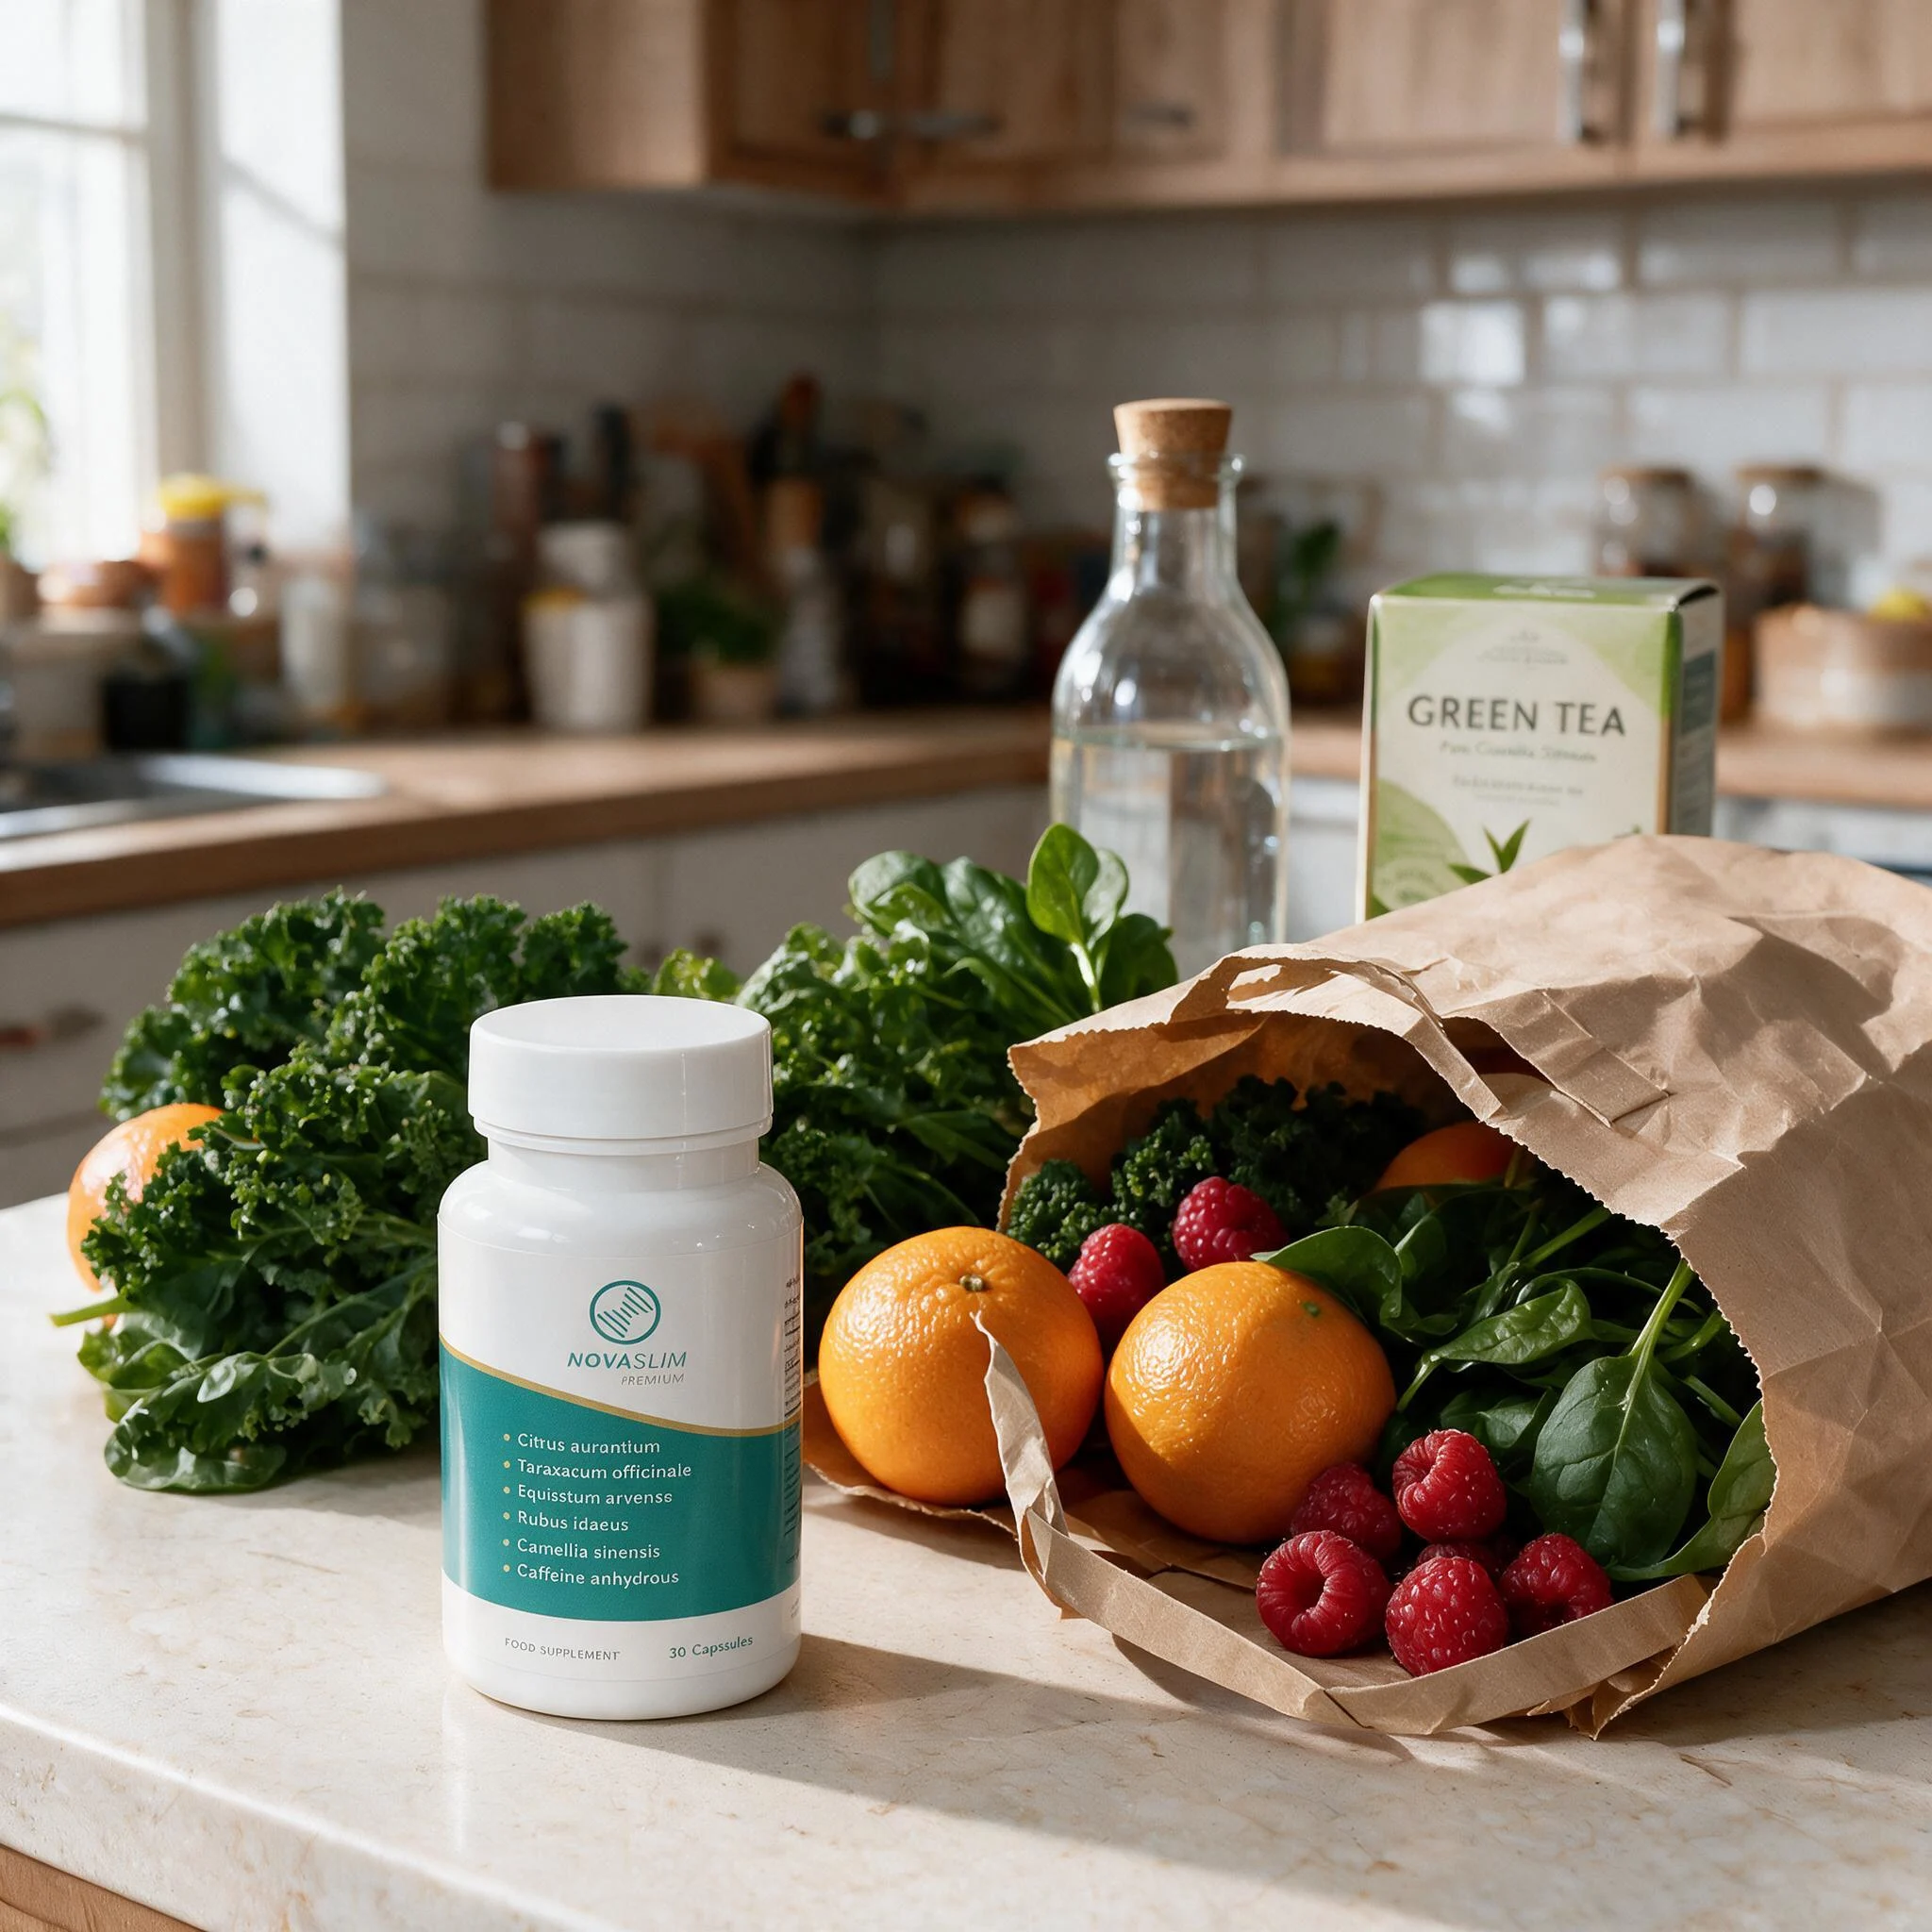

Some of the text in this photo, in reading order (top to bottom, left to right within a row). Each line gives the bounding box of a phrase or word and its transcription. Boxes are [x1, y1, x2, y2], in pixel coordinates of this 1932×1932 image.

[1407, 694, 1626, 737] GREEN TEA
[568, 1352, 686, 1369] NOVASLIM
[622, 1374, 684, 1385] PREMIUM
[518, 1434, 659, 1454] Citrus aurantium
[518, 1459, 691, 1478] Taraxacum officinale
[519, 1510, 628, 1531] Rubus idaeus
[518, 1539, 659, 1558] Camellia sinensis
[518, 1564, 678, 1589] Caffeine anhydrous
[506, 1638, 620, 1659] FOOD SUPPLEMENT
[670, 1637, 753, 1658] 30 Capssules
